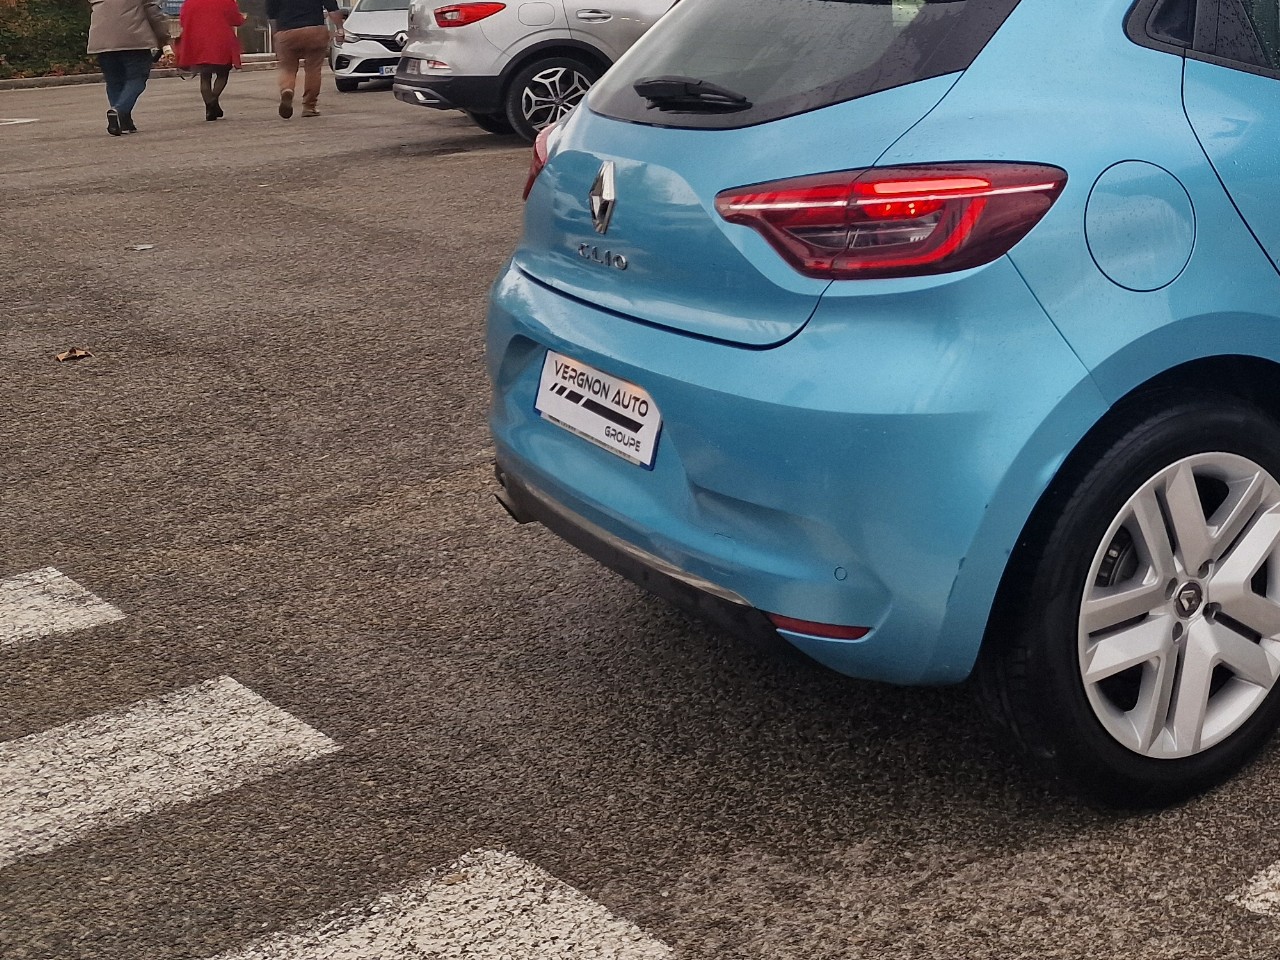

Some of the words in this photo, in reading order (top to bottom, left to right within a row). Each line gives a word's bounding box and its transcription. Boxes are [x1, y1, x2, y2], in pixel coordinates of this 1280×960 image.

[578, 243, 628, 270] CLIO
[555, 360, 610, 400] VERGNON
[611, 389, 649, 418] AUTO
[605, 425, 641, 452] GROUPE
